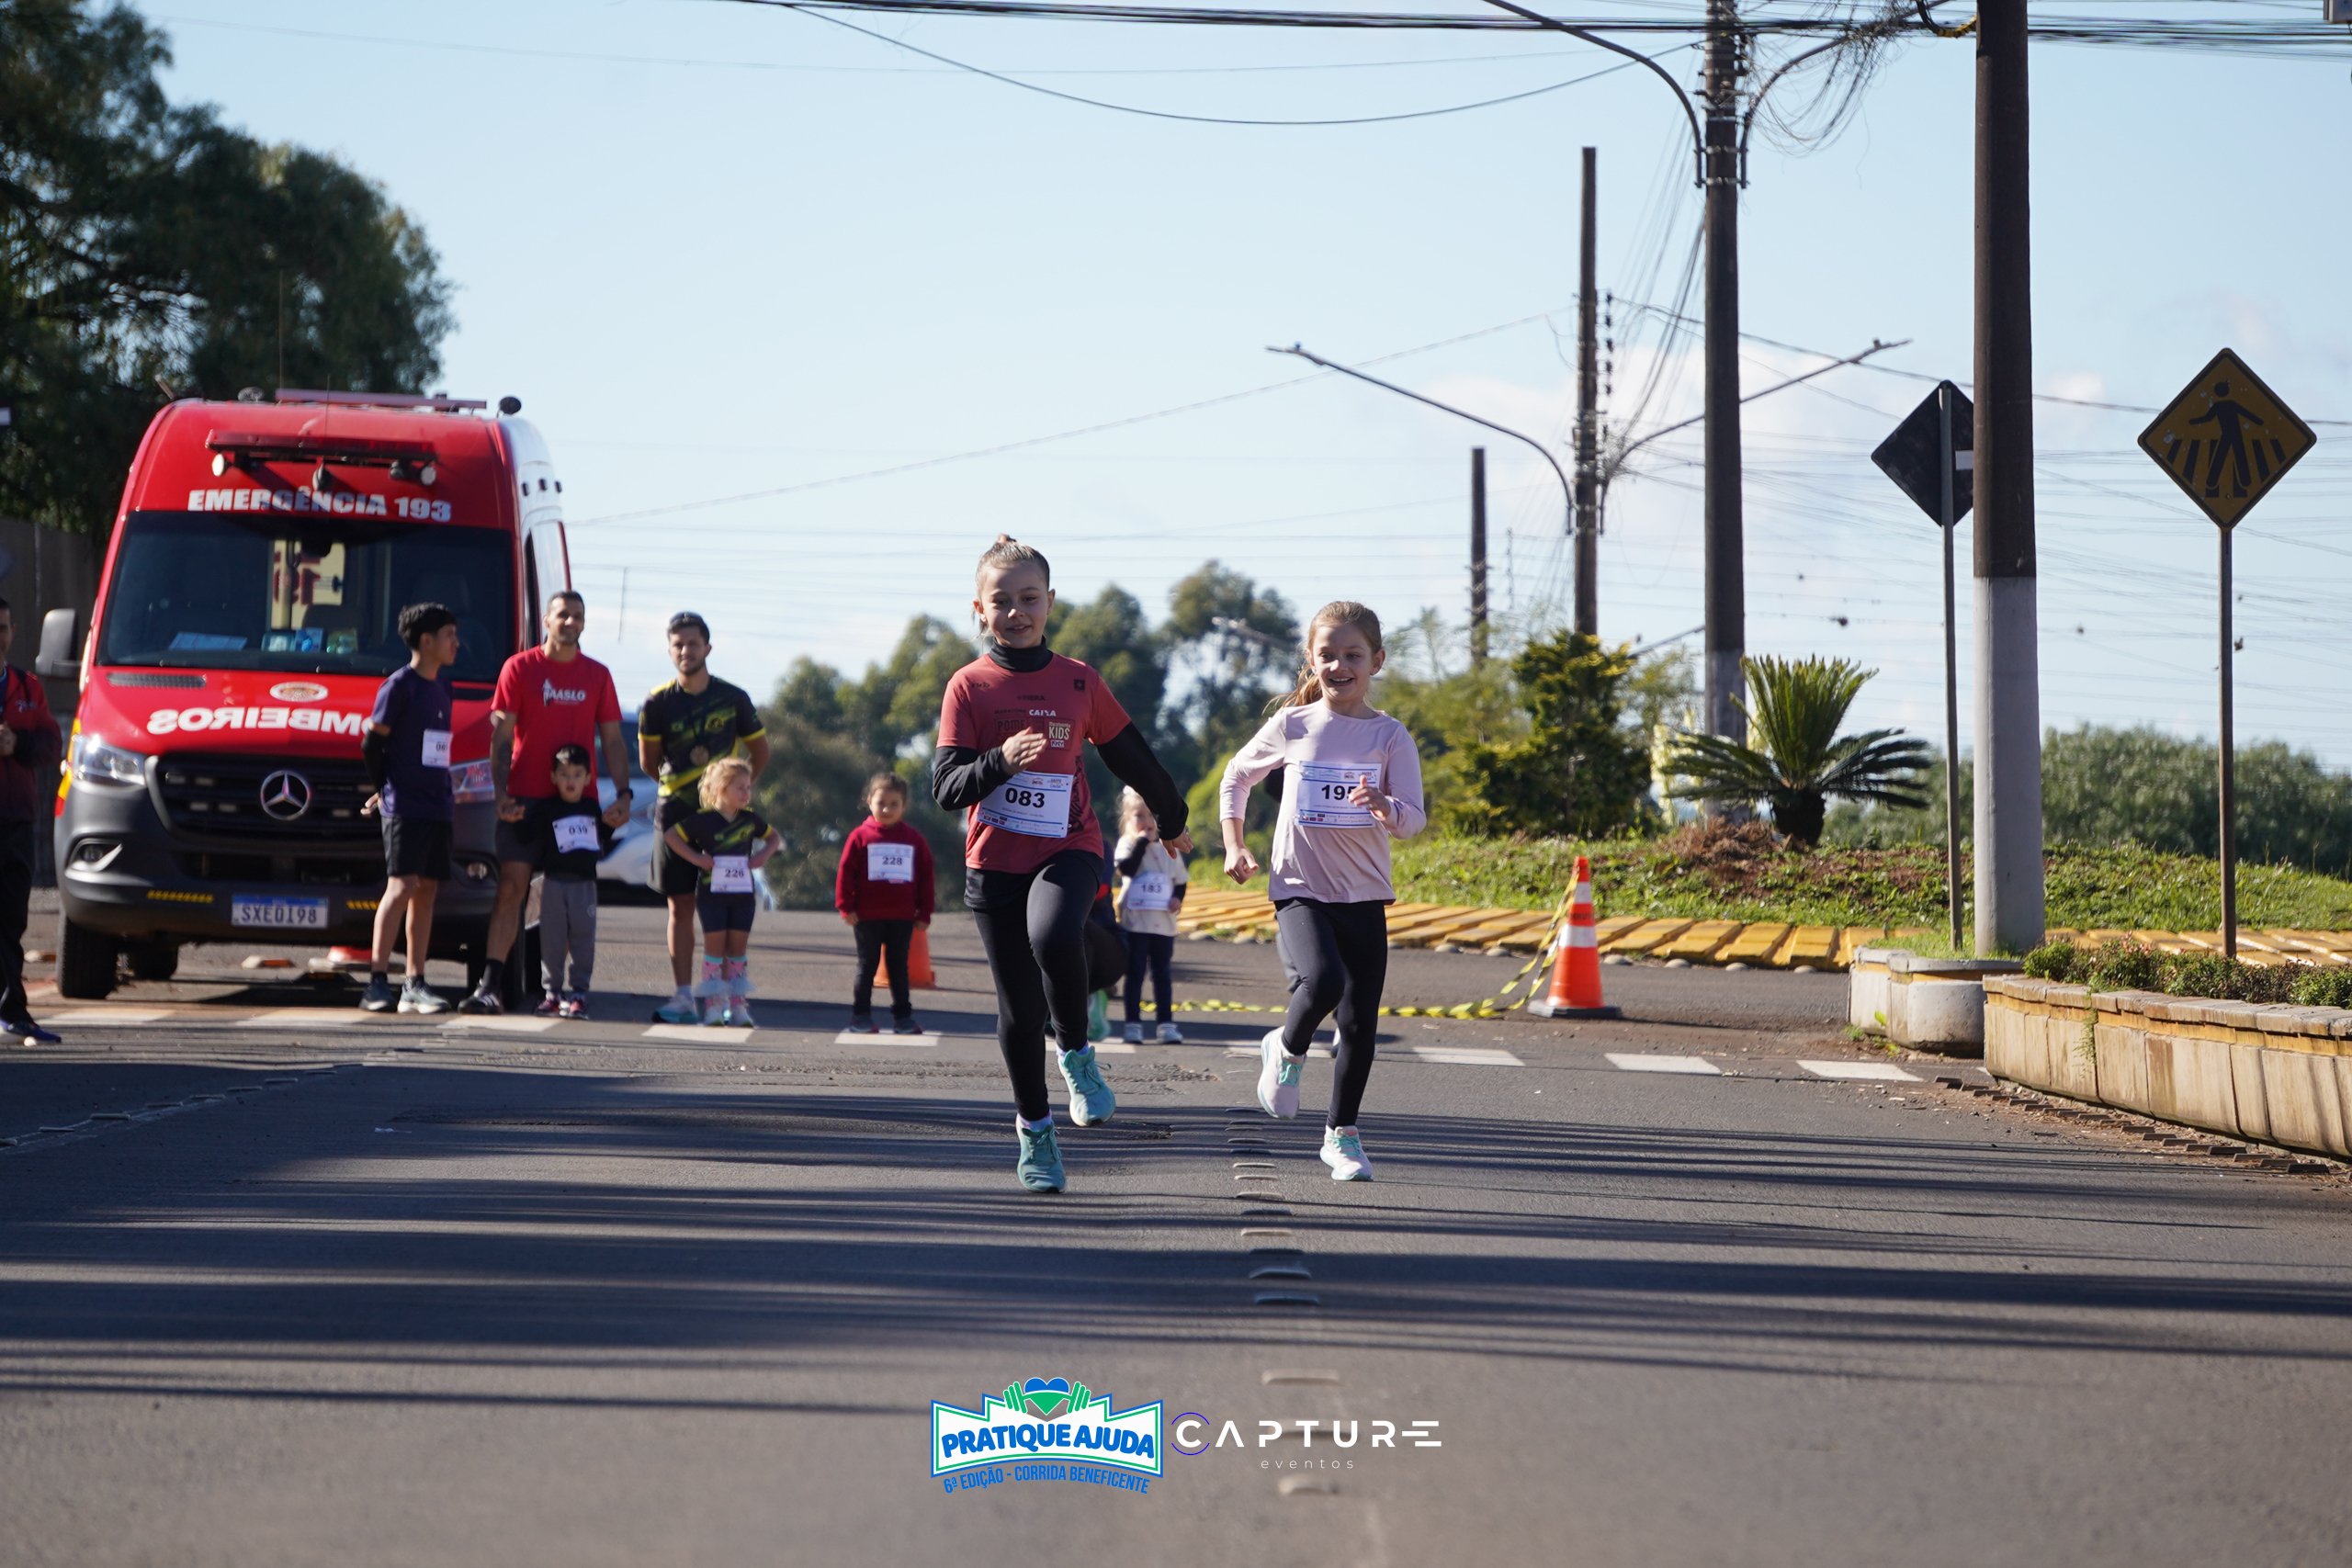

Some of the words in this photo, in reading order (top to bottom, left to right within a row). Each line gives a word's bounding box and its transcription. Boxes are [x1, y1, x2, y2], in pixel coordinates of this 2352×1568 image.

[187, 486, 387, 515] EMERGÊNCIA
[394, 497, 452, 522] 193
[1048, 727, 1070, 739] KIDS
[1005, 787, 1045, 808] 083
[881, 856, 903, 865] 228
[724, 867, 744, 878] 226
